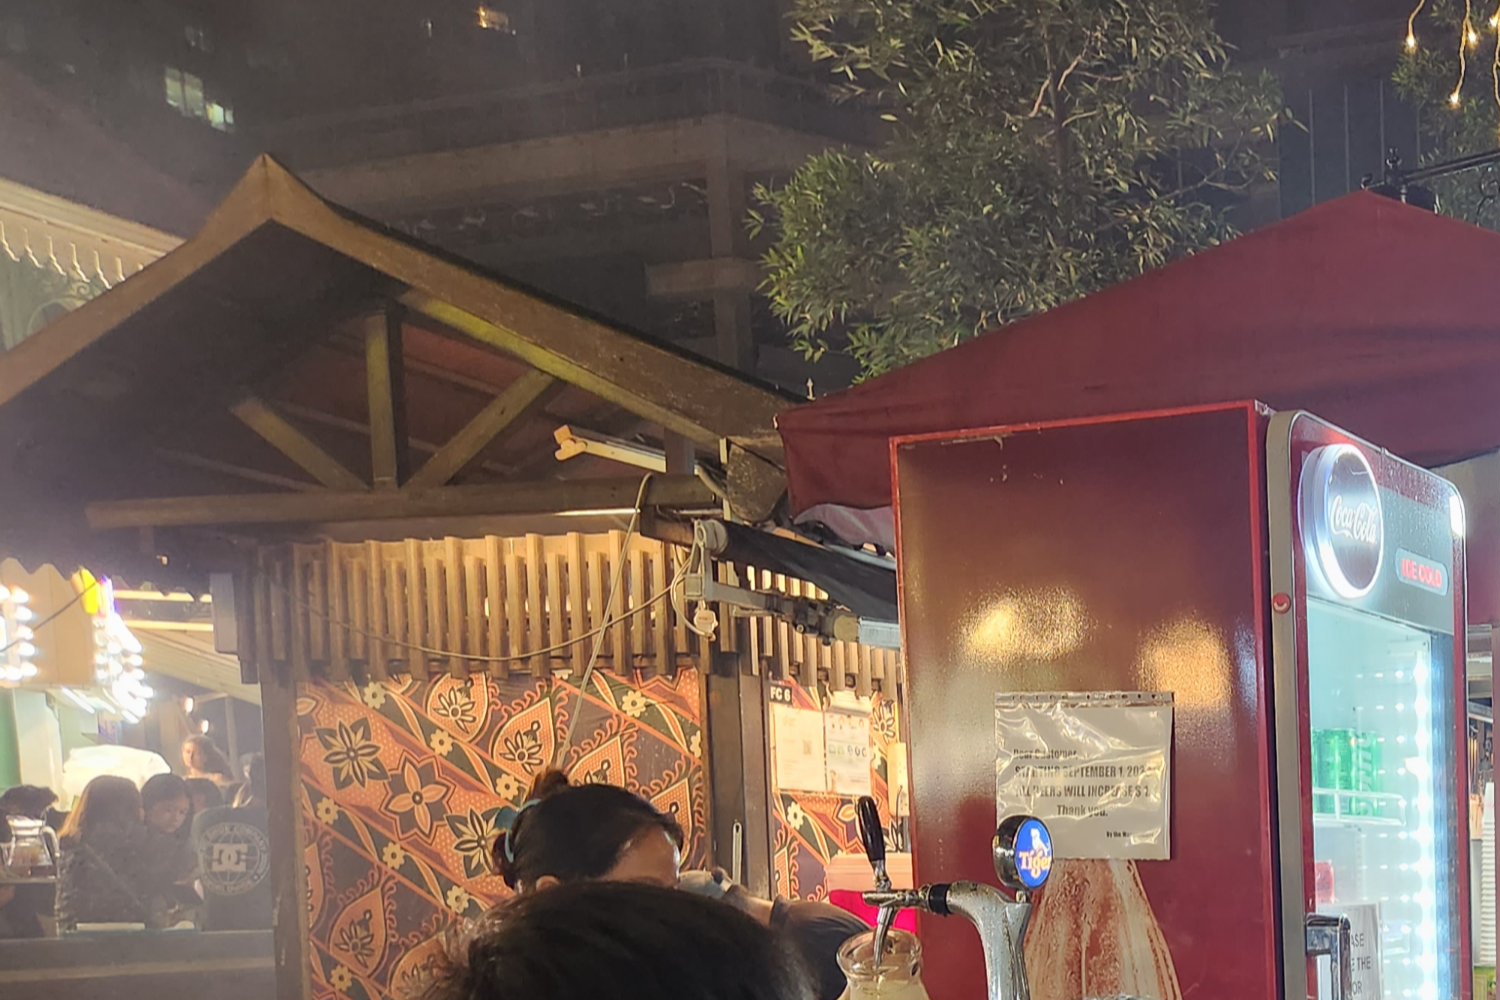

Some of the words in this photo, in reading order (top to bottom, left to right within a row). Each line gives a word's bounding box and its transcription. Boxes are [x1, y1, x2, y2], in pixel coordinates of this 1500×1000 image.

[1401, 558, 1418, 580] ICE
[1418, 563, 1442, 588] COLD
[770, 686, 783, 700] FC
[784, 689, 791, 702] 6
[1062, 765, 1117, 778] SEPTEMBER
[1063, 785, 1086, 797] WILL
[1056, 804, 1086, 816] Thank
[1087, 806, 1109, 818] you.
[1356, 956, 1372, 971] THE
